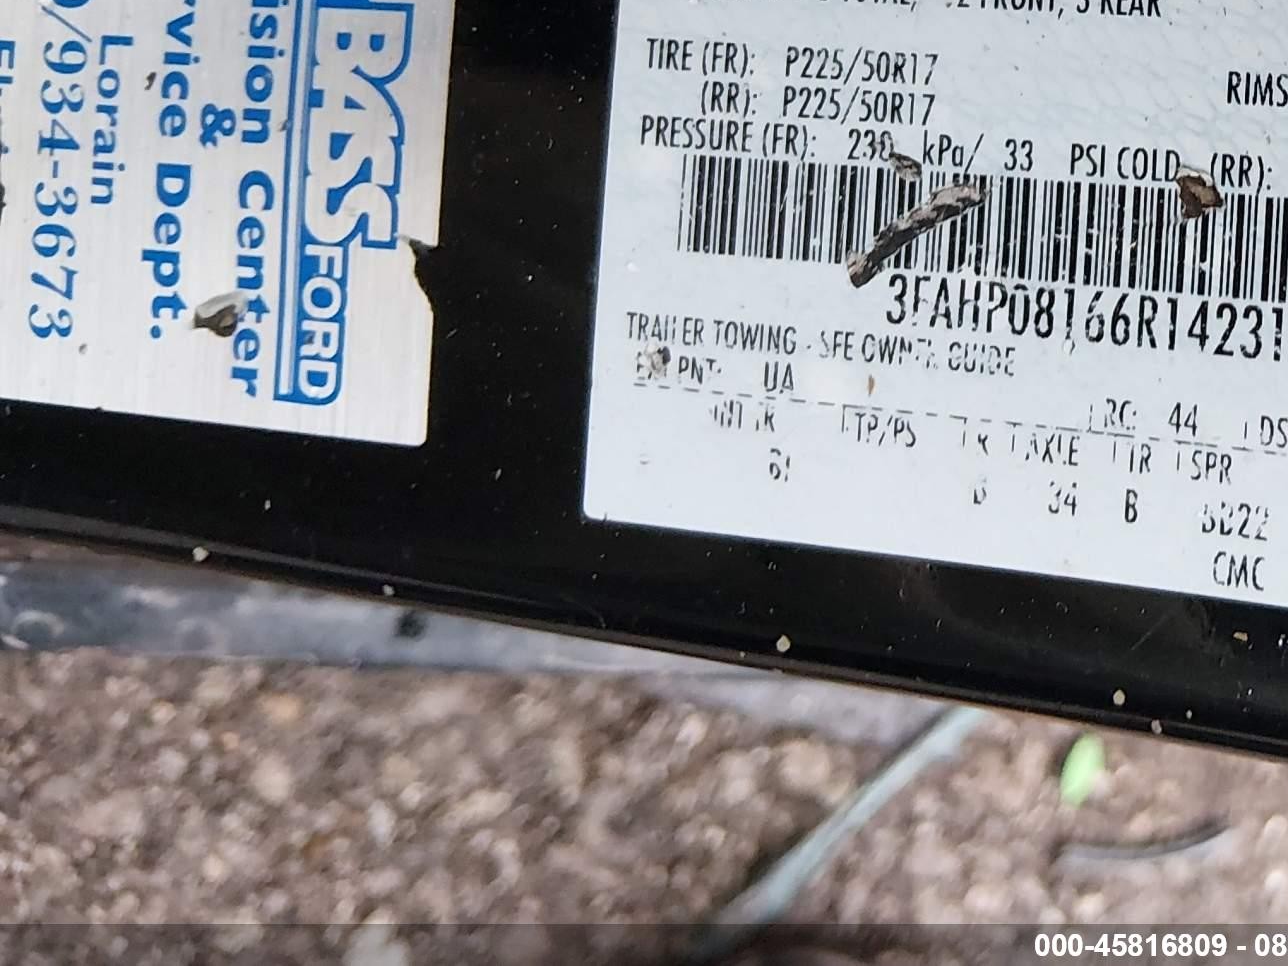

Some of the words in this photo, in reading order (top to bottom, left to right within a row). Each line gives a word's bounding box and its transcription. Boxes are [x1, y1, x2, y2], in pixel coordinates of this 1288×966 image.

[646, 37, 693, 72] TIRE
[702, 40, 754, 77] (FR):
[785, 45, 939, 85] P225/50R17
[1226, 70, 1288, 107] RIMS
[91, 34, 134, 205] Lorain
[200, 103, 237, 148] &
[304, 4, 413, 250] BASS
[701, 80, 757, 117] (RR):
[782, 86, 936, 127] P225/50R17
[640, 115, 753, 153] PRESSURE
[762, 121, 816, 159] (FR):
[922, 129, 985, 174] kPa/
[1003, 138, 1034, 172] 33
[1069, 143, 1107, 179] PSI
[1116, 146, 1182, 183] COLD
[1210, 151, 1272, 192] (RR):
[142, 163, 191, 340] Dept.
[231, 169, 275, 398] Center
[298, 244, 344, 400] FORD
[713, 319, 797, 355] TOWING
[763, 361, 795, 393] UA
[1167, 403, 1199, 437] 44
[1190, 449, 1233, 485] SPR
[1124, 488, 1139, 524] B
[1212, 551, 1264, 592] CMC
